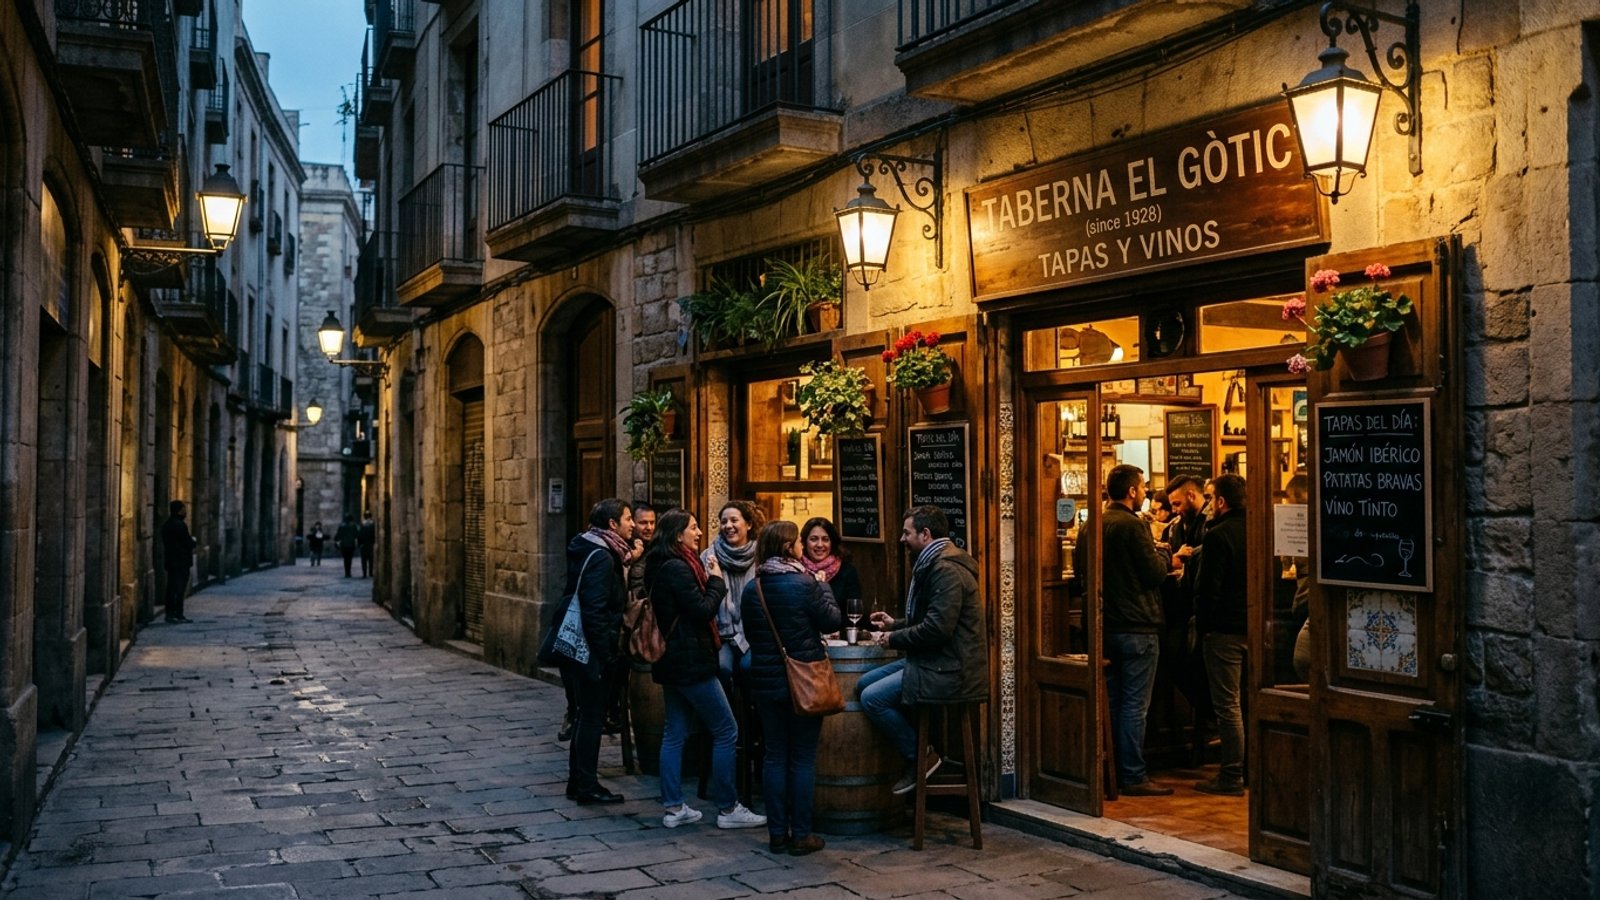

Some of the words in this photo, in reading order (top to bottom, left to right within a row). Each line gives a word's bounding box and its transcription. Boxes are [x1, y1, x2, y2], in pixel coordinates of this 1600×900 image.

[981, 168, 1117, 233] TABERNA
[1127, 157, 1167, 202] EL
[1177, 123, 1293, 190] GÒTIC
[1085, 217, 1121, 238] (since
[1124, 204, 1162, 229] 1928)
[1038, 242, 1110, 278] TAPAS
[1117, 237, 1132, 264] Y
[1139, 219, 1221, 260] VINOS
[1323, 414, 1363, 432] TAPAS
[1365, 415, 1389, 430] DEL
[1323, 442, 1364, 464] JAMÓN
[1323, 471, 1373, 489] PATATAS
[1377, 473, 1423, 491] BRAVAS
